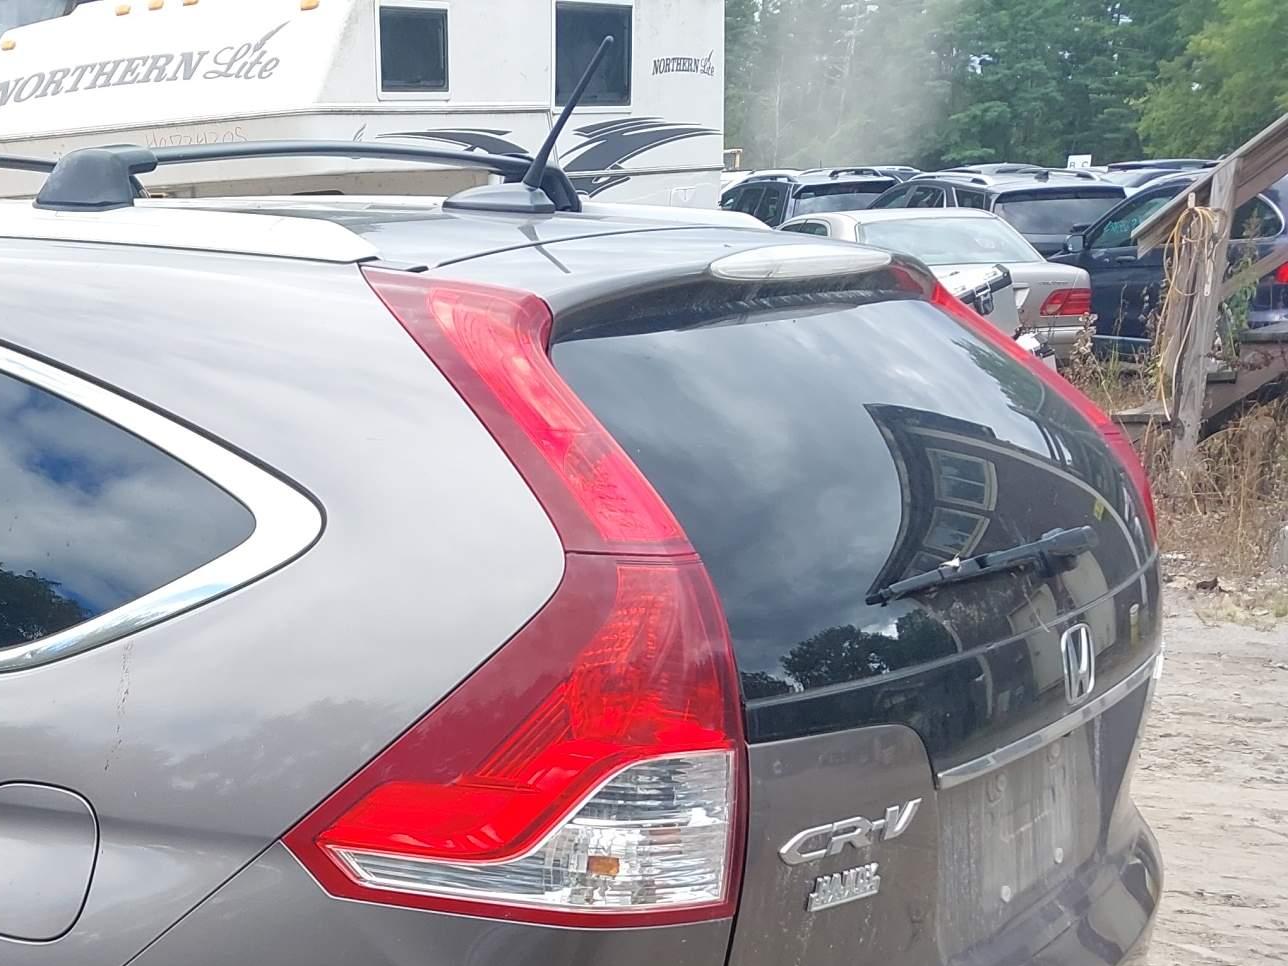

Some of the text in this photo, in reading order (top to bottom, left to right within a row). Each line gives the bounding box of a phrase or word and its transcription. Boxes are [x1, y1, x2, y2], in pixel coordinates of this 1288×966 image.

[202, 32, 284, 81] Lite
[651, 56, 700, 76] NORTHERN
[778, 797, 923, 866] CR-V
